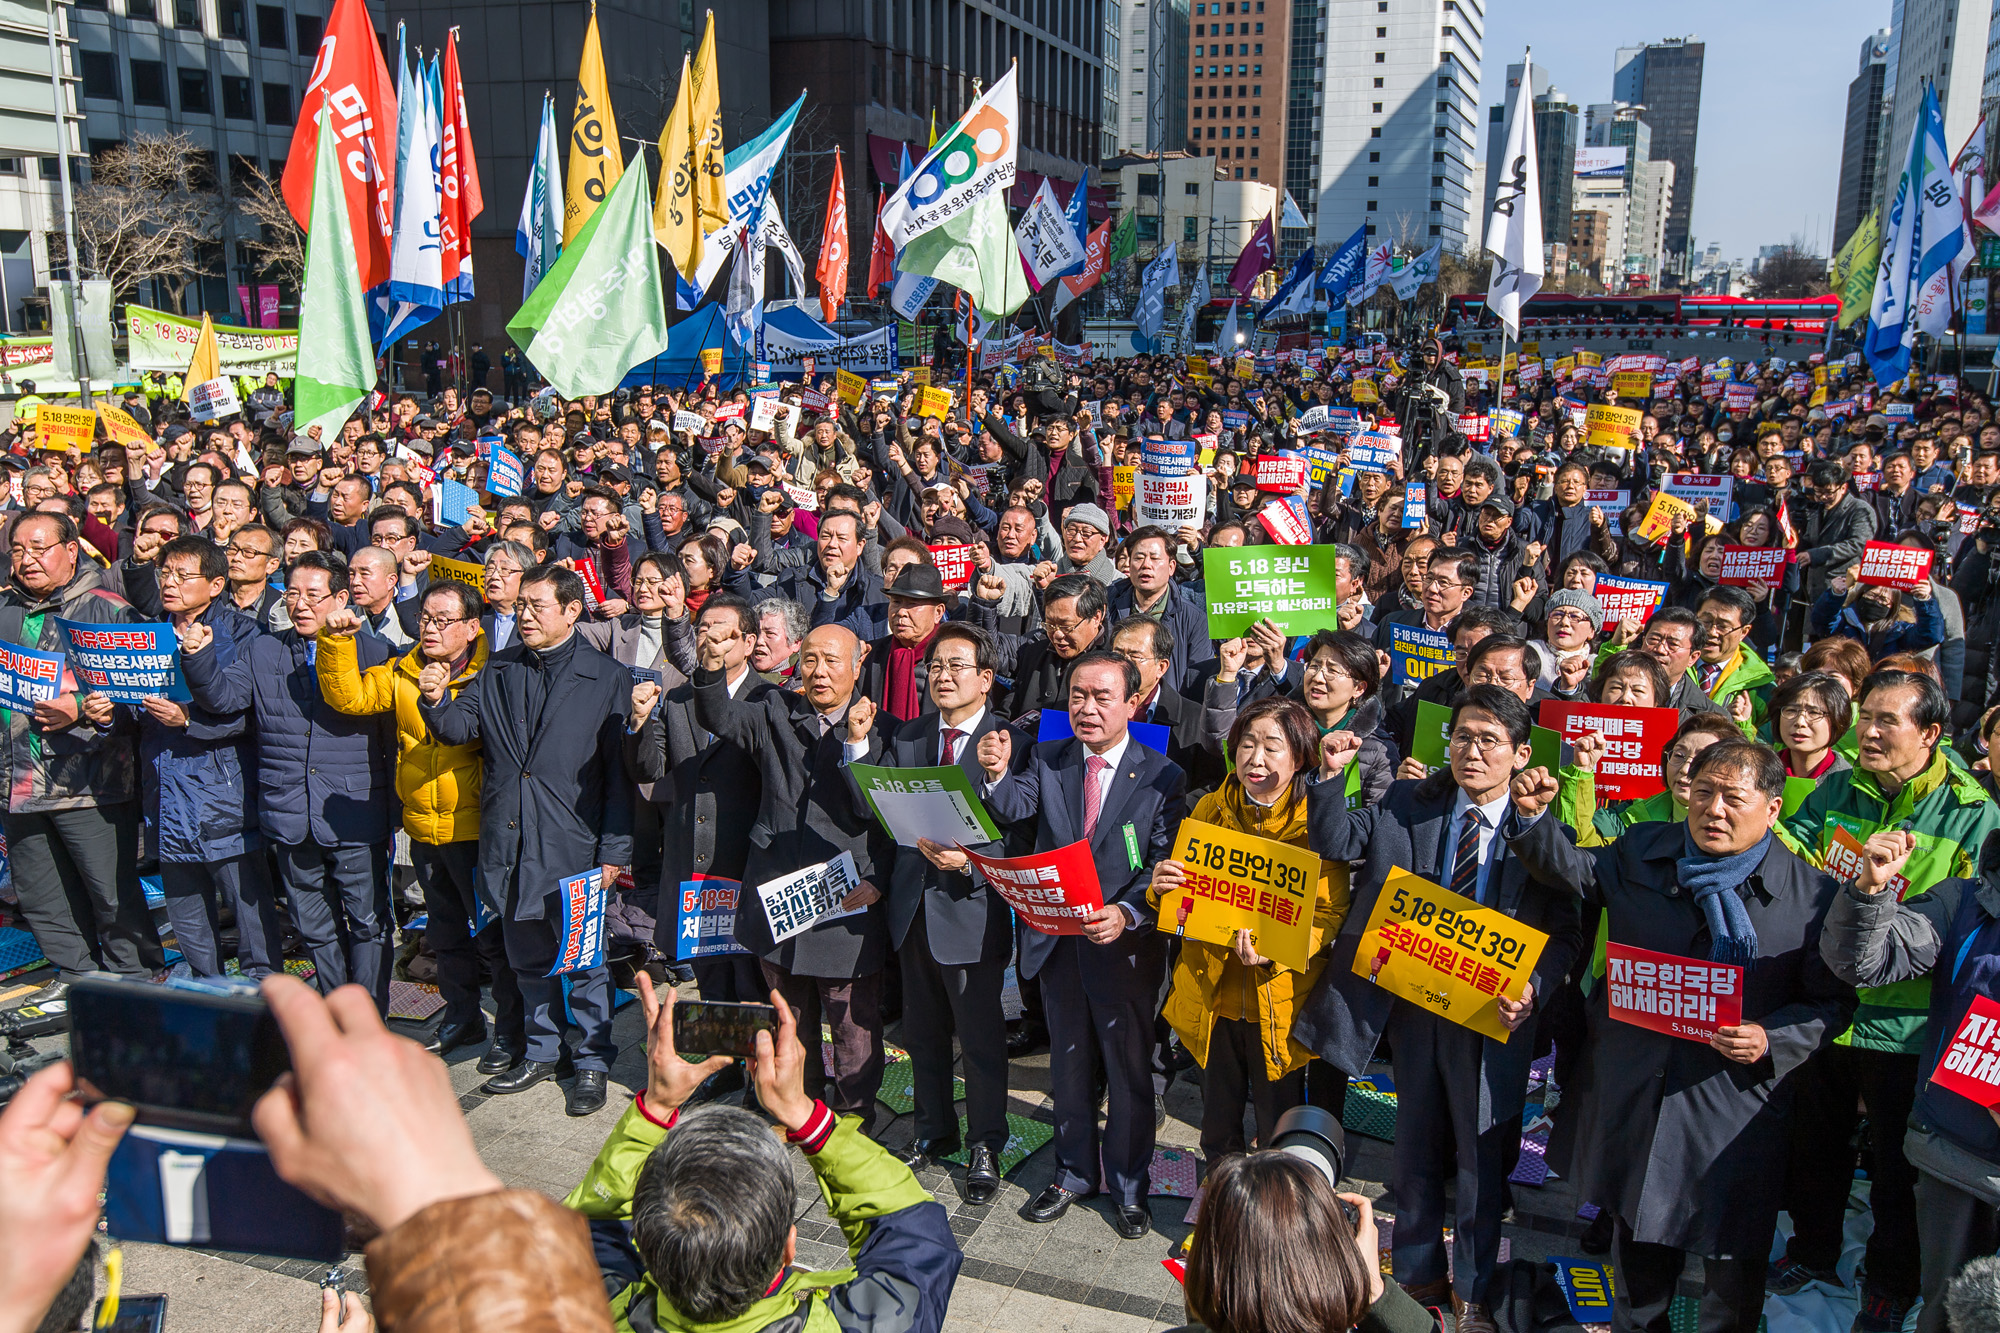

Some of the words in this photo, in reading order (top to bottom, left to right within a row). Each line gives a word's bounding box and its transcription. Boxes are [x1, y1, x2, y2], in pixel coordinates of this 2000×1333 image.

[42, 411, 63, 423] 5.18
[63, 413, 81, 425] 망언
[81, 415, 93, 427] 3인
[103, 407, 121, 422] 5.18
[1588, 410, 1604, 421] 5.18
[1604, 412, 1624, 425] 망언
[1623, 415, 1636, 426] 3인
[41, 423, 76, 436] 국회의원
[1258, 461, 1305, 474] 자유한국당
[1143, 479, 1188, 494] 5.18역사
[1143, 493, 1163, 506] 왜곡
[1165, 493, 1192, 506] 처벌!
[1141, 506, 1169, 520] 특별법
[1171, 506, 1197, 520] 개정!
[1229, 558, 1269, 576] 5.18
[1273, 556, 1310, 574] 정신
[1723, 550, 1786, 565] 자유한국당
[1864, 548, 1930, 565] 자유한국당
[433, 563, 453, 580] 5.18
[1721, 564, 1775, 579] 해체하라!
[1860, 562, 1918, 580] 해체하라!
[1235, 578, 1305, 598] 모독하는
[1211, 600, 1273, 615] 자유한국당
[1275, 597, 1332, 612] 해산하라!
[68, 628, 157, 650] 자유한국당!
[1393, 626, 1410, 642] 5·18
[1394, 639, 1418, 656] 김진태,
[1418, 643, 1445, 661] 이종명,
[75, 666, 110, 686] 추천권
[110, 671, 176, 688] 반납하라!
[1406, 658, 1457, 680] OUT
[17, 678, 54, 703] 제정!
[1565, 714, 1644, 738] 탄핵폐족
[1601, 762, 1663, 778] 제명하라!
[980, 861, 1061, 885] 탄핵폐족
[1184, 837, 1226, 870] 5.18
[1228, 848, 1273, 886] 망언
[1273, 863, 1308, 899] 3인
[764, 870, 818, 908] 5.18모독
[769, 866, 848, 920] 역사왜곡
[1180, 868, 1257, 912] 국회의원
[1256, 890, 1303, 927] 퇴출!
[1030, 902, 1094, 919] 제명하라!
[682, 914, 735, 941] 처벌법
[1389, 888, 1436, 926] 5.18
[1434, 907, 1486, 952] 망언
[1481, 931, 1527, 971] 3인
[577, 915, 599, 969] 처벌법
[1378, 918, 1459, 976] 국회의원
[1455, 957, 1512, 998] 퇴출!
[1608, 957, 1737, 996] 자유한국당
[1425, 990, 1452, 1011] 정의당
[1610, 982, 1716, 1022] 해체하라!
[1671, 1022, 1714, 1040] 5.18시국
[1568, 1266, 1609, 1307] OUT!
